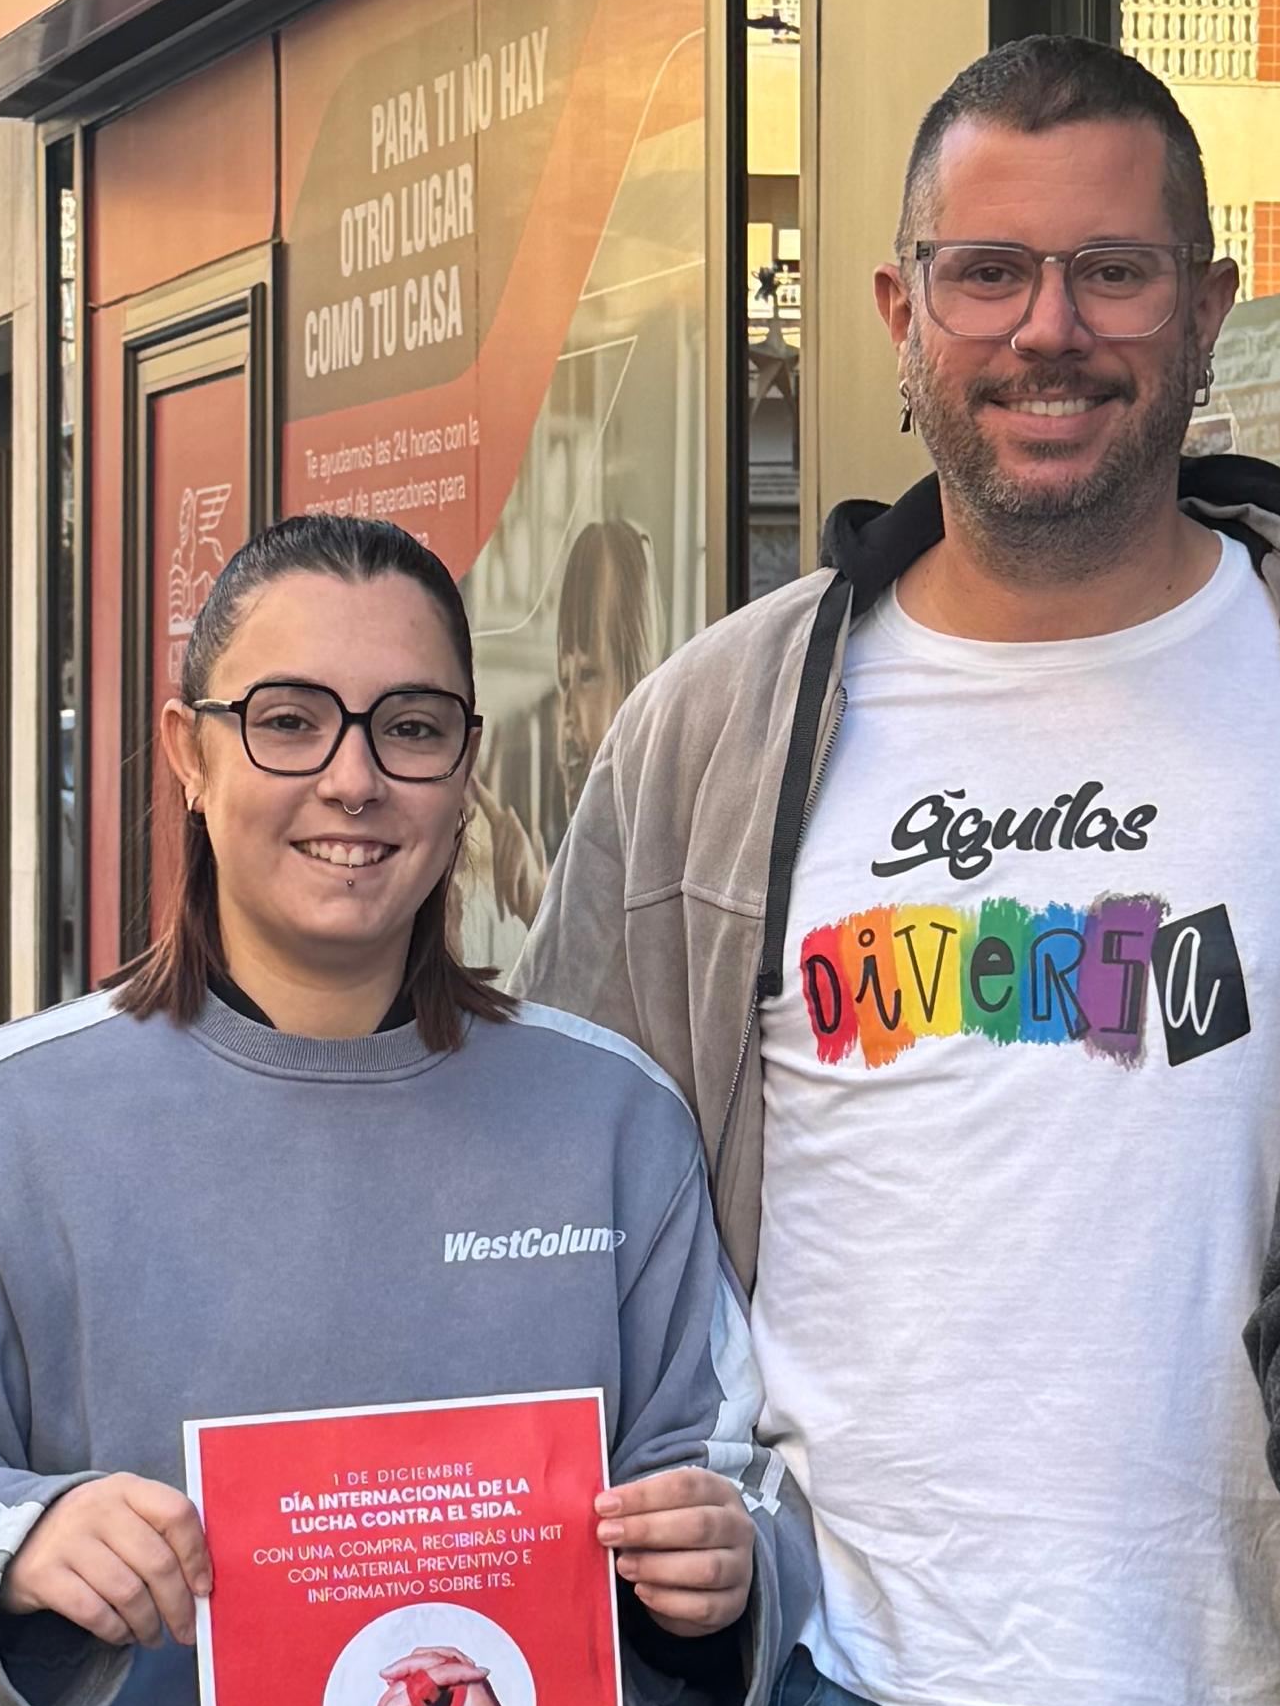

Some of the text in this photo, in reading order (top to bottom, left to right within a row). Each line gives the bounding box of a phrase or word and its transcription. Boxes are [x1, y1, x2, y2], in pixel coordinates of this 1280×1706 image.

[371, 26, 549, 174] PARA TI NO HAY
[340, 163, 475, 278] OTRO LUGAR
[304, 265, 463, 379] COMO TU CASA
[305, 449, 318, 479] Te
[319, 442, 373, 484] ayudamos
[375, 435, 391, 466] las
[393, 430, 408, 462] 24
[410, 426, 442, 457] horas
[444, 422, 467, 451] con
[439, 474, 466, 512] para
[347, 1470, 370, 1485] DE
[377, 1462, 474, 1483] DICIEMBRE
[280, 1477, 530, 1513] DÍA INTERNACIONAL DE LA
[291, 1500, 522, 1534] LUCHA CONTRA EL SIDA.
[253, 1523, 564, 1566] CON UNA COMPRA, RECIBIRÁS UN KIT
[287, 1548, 533, 1584] CON MATERIAL PREVENTIVO E
[307, 1572, 516, 1604] INFORMATIVO SOBRE ITS.
